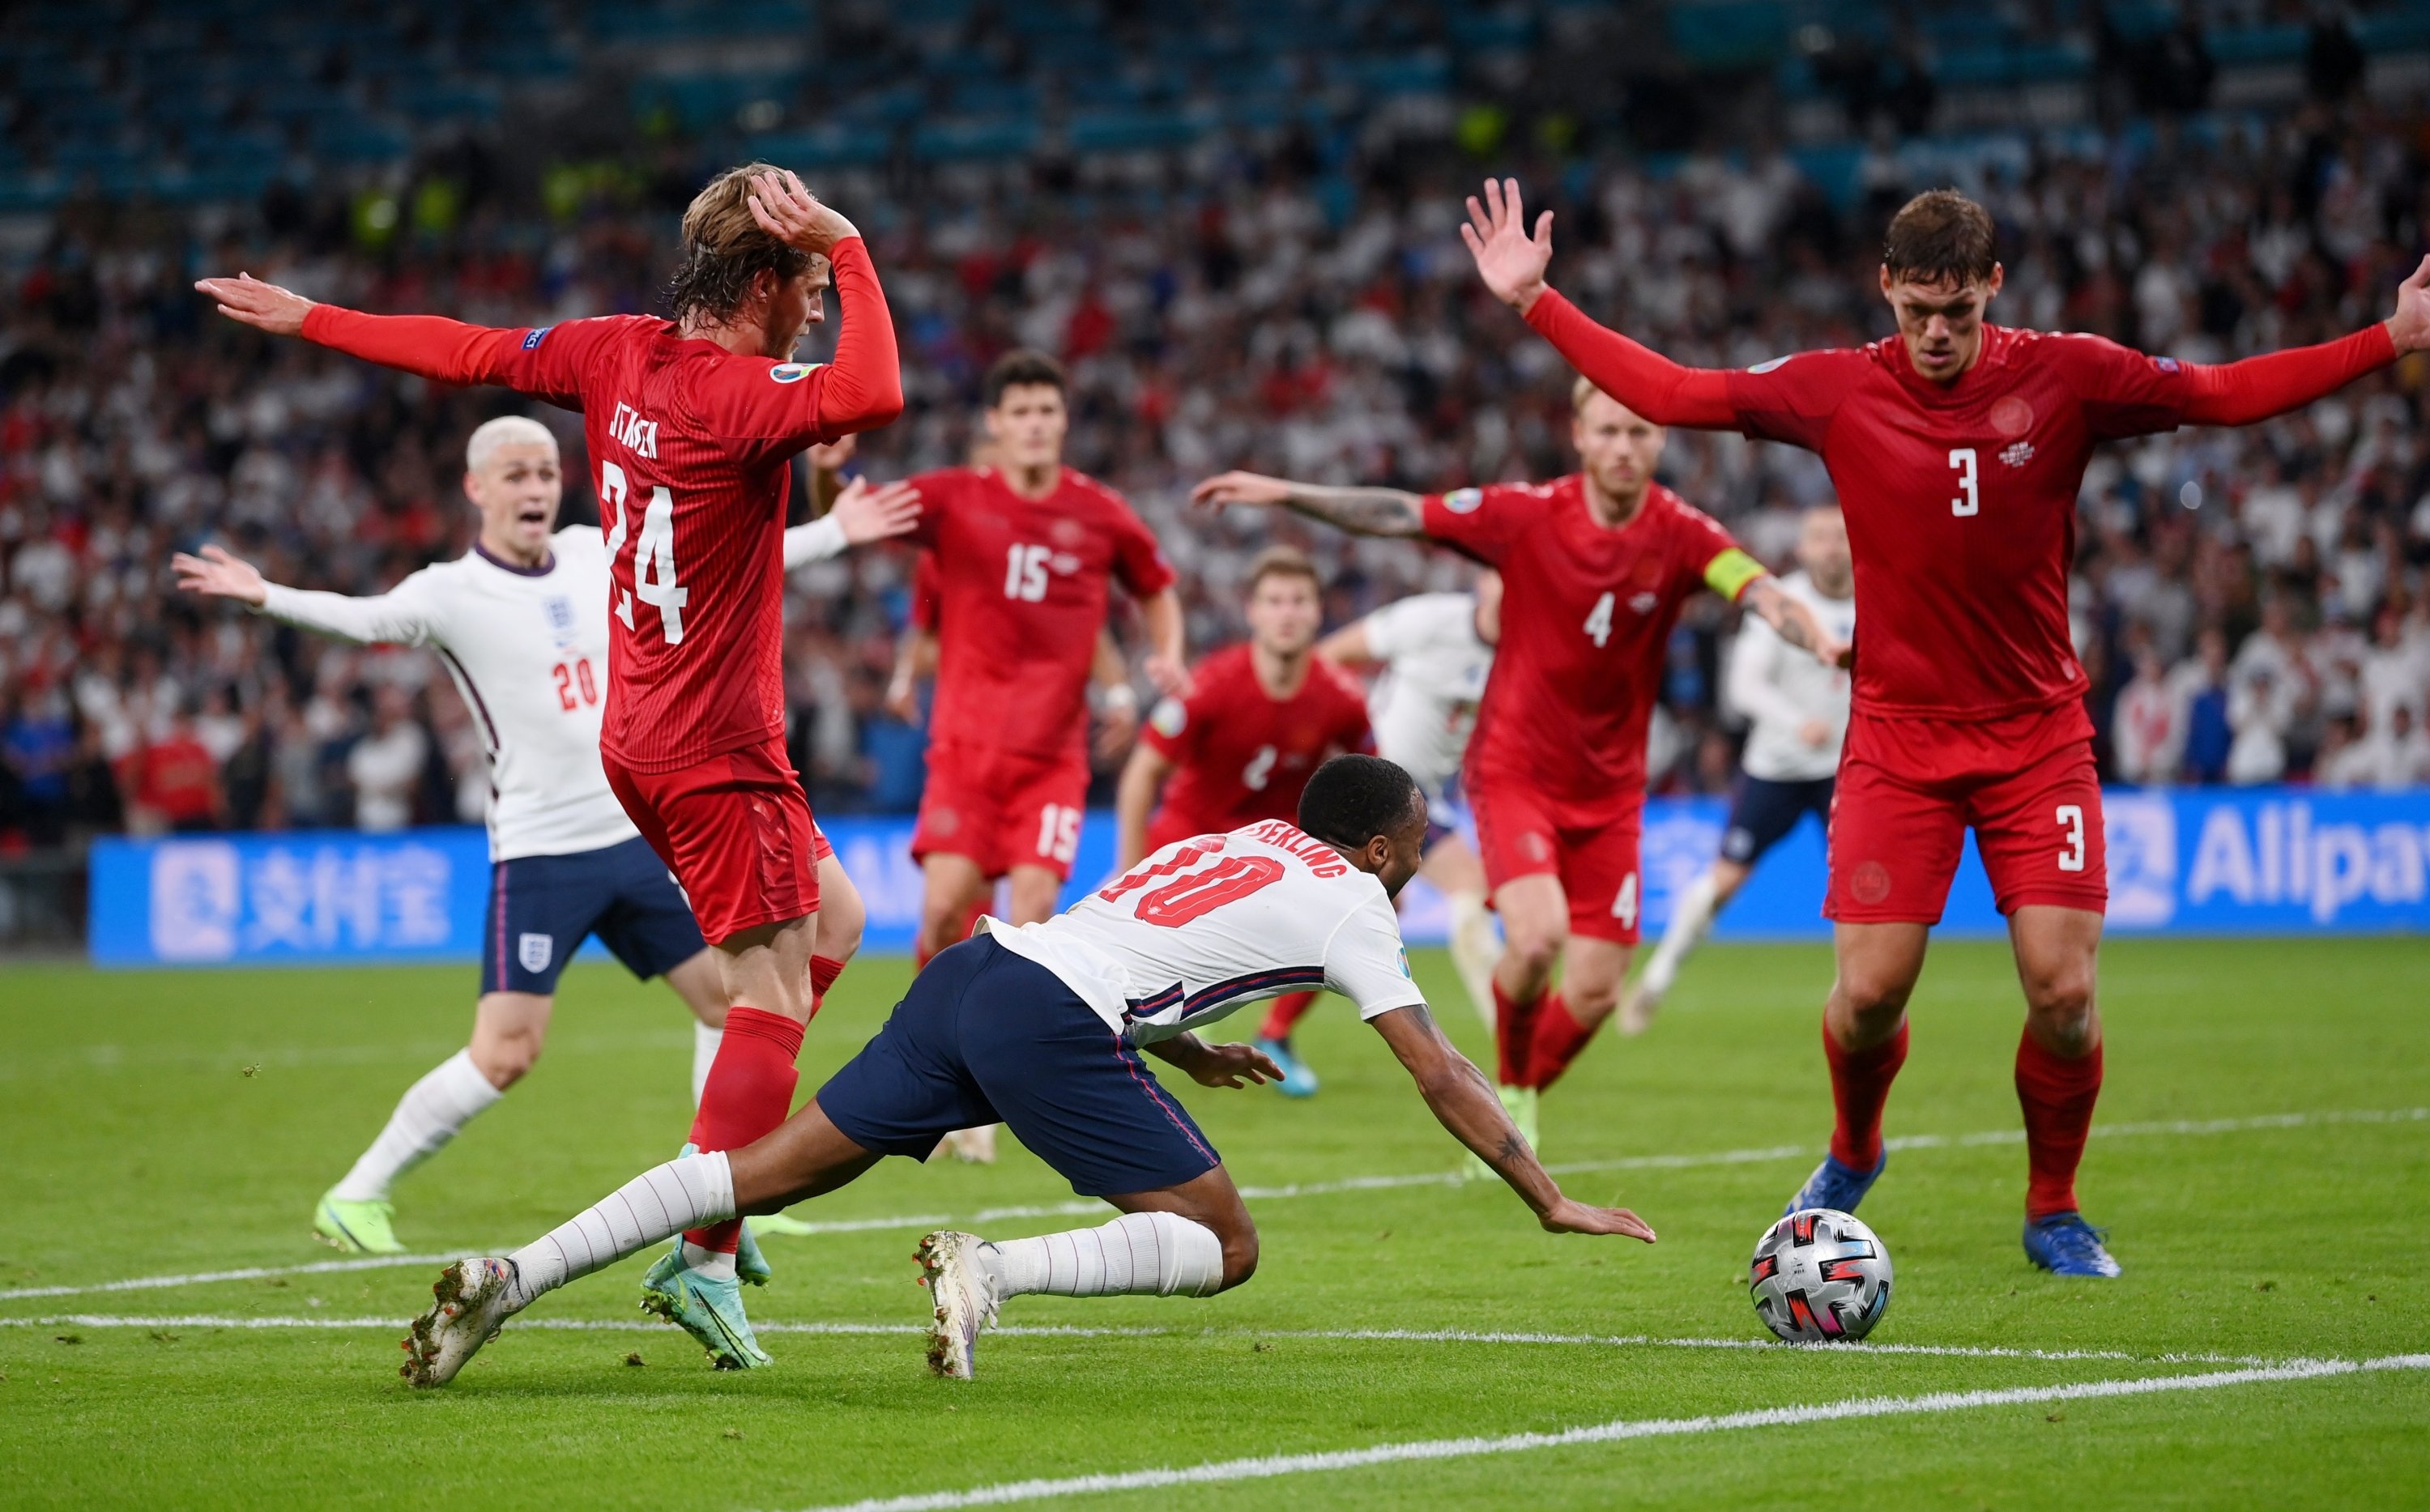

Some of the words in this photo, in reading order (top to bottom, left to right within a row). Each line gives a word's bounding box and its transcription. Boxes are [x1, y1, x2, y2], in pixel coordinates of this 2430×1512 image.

[1949, 447, 1979, 517] 3
[602, 459, 688, 645] 24
[1004, 543, 1053, 603] 15
[1583, 592, 1616, 648] 4
[552, 658, 598, 711] 20
[1036, 803, 1081, 864] 15
[2055, 804, 2085, 872] 3
[2190, 799, 2430, 923] Alipa
[1098, 835, 1286, 929] 10
[1611, 871, 1638, 931] 4
